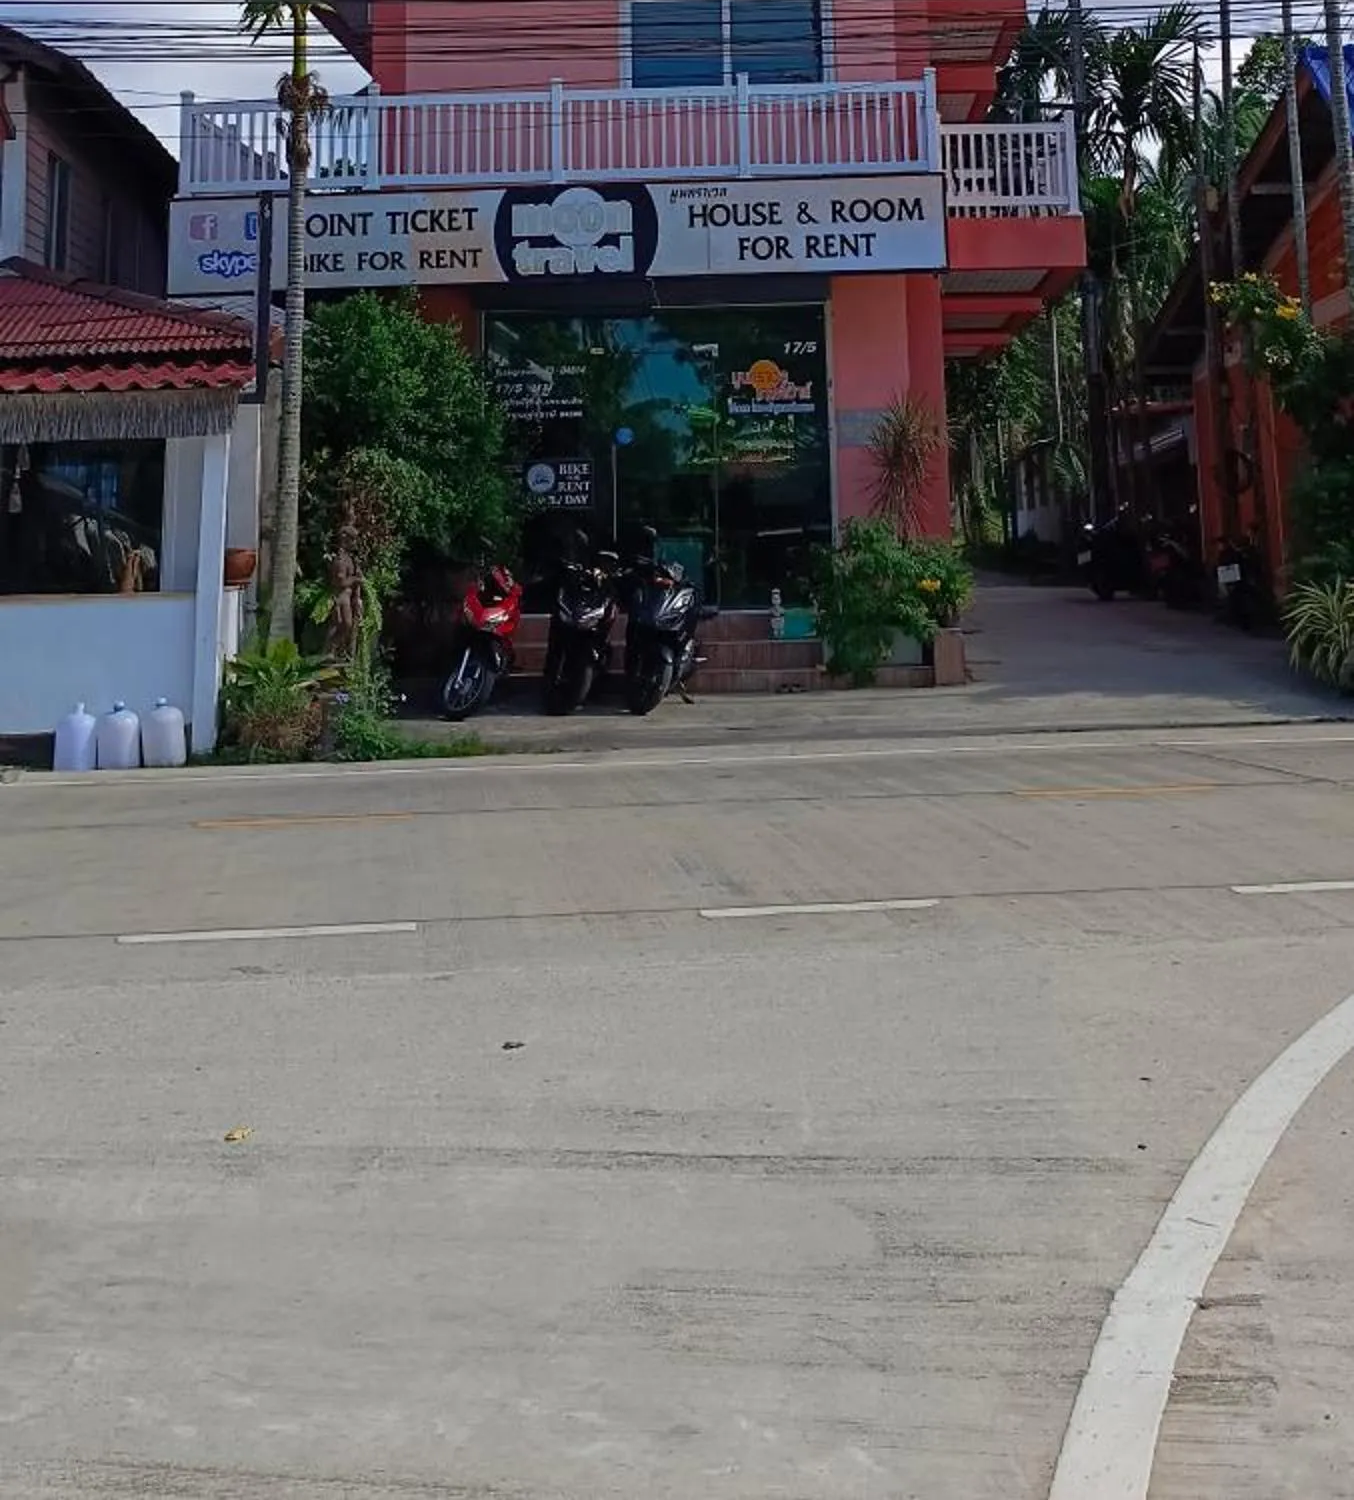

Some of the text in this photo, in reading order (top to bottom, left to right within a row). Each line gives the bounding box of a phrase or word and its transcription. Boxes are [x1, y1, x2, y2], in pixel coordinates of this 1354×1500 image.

[303, 207, 479, 239] OINT TICKET
[688, 198, 925, 229] HOUSE & ROOM
[738, 233, 877, 261] FOR RENT
[357, 251, 406, 272] FOR
[418, 248, 482, 270] RENT
[783, 341, 817, 355] 17/5
[559, 463, 590, 475] BIKE
[557, 481, 592, 492] RENT
